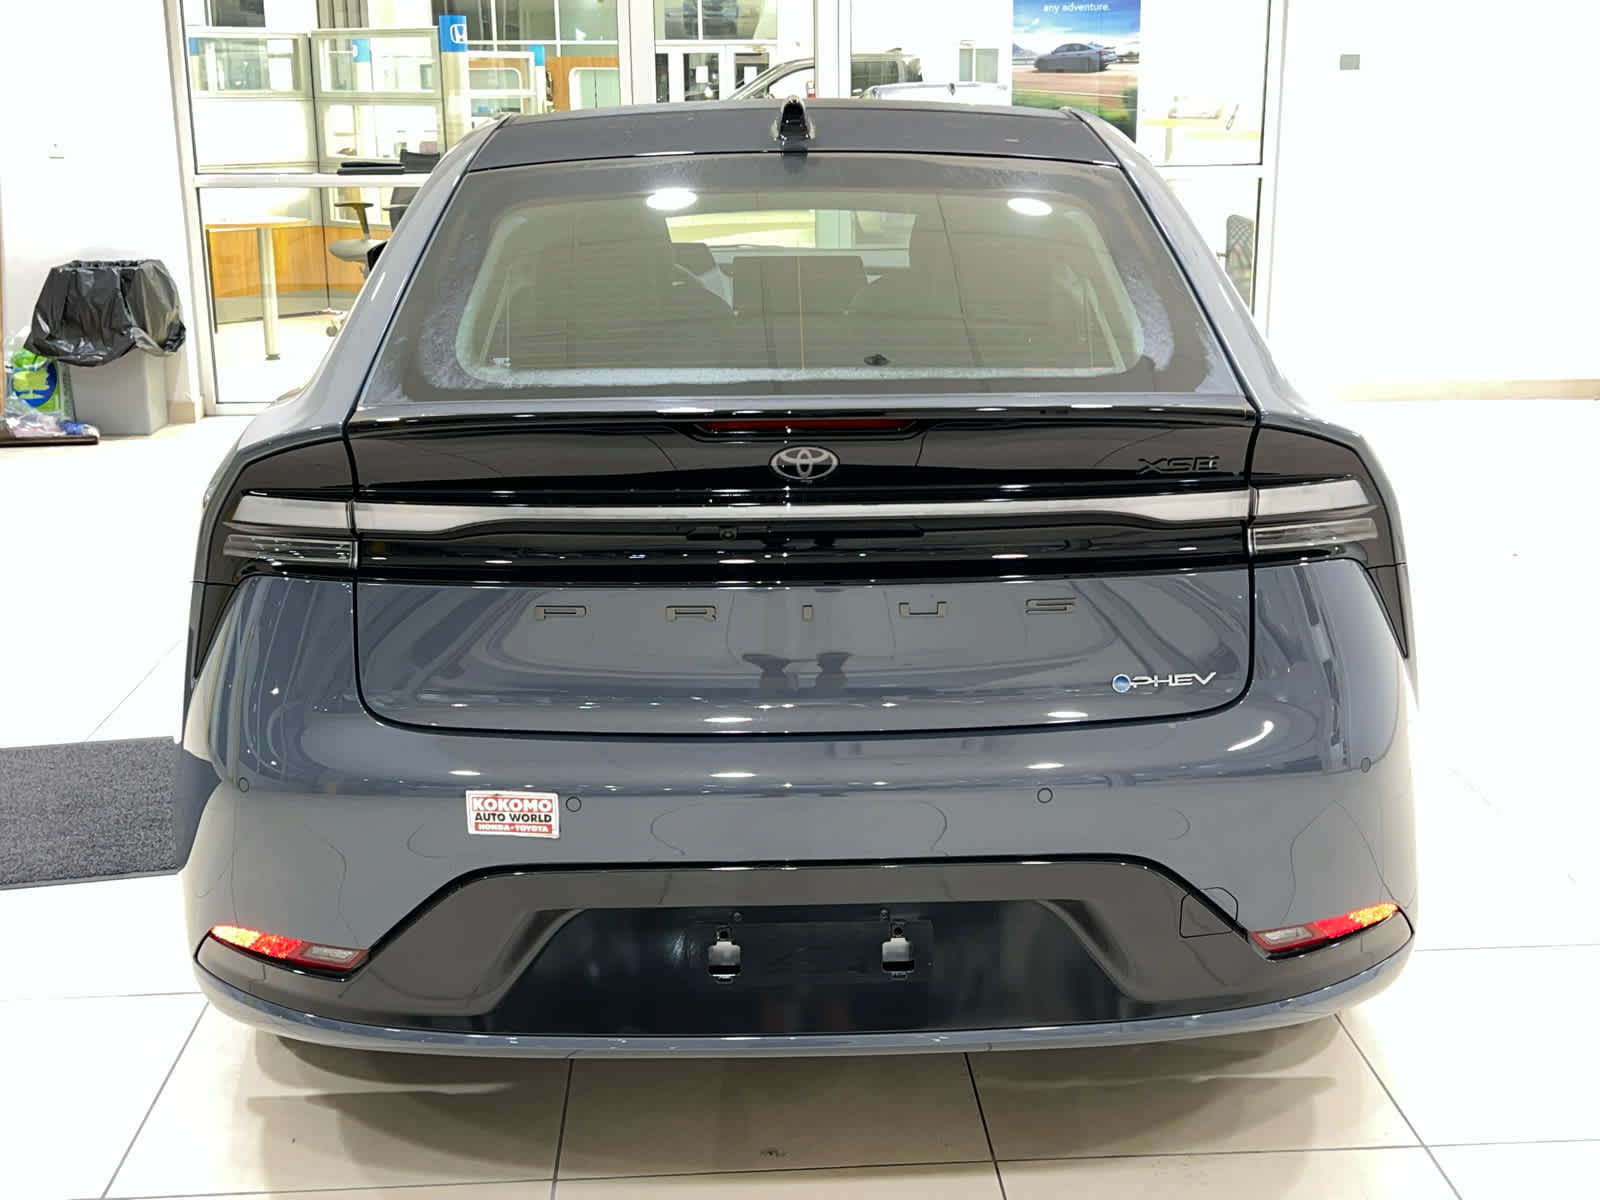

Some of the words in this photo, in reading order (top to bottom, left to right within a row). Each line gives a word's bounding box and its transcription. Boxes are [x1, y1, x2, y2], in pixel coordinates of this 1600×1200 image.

[1043, 4, 1059, 15] any
[1138, 456, 1219, 473] XSE
[535, 598, 1076, 622] PRIUS
[1130, 672, 1216, 688] PHEV
[473, 798, 552, 812] KOKOMO
[475, 813, 505, 822] AUTO
[509, 814, 552, 823] WORLD
